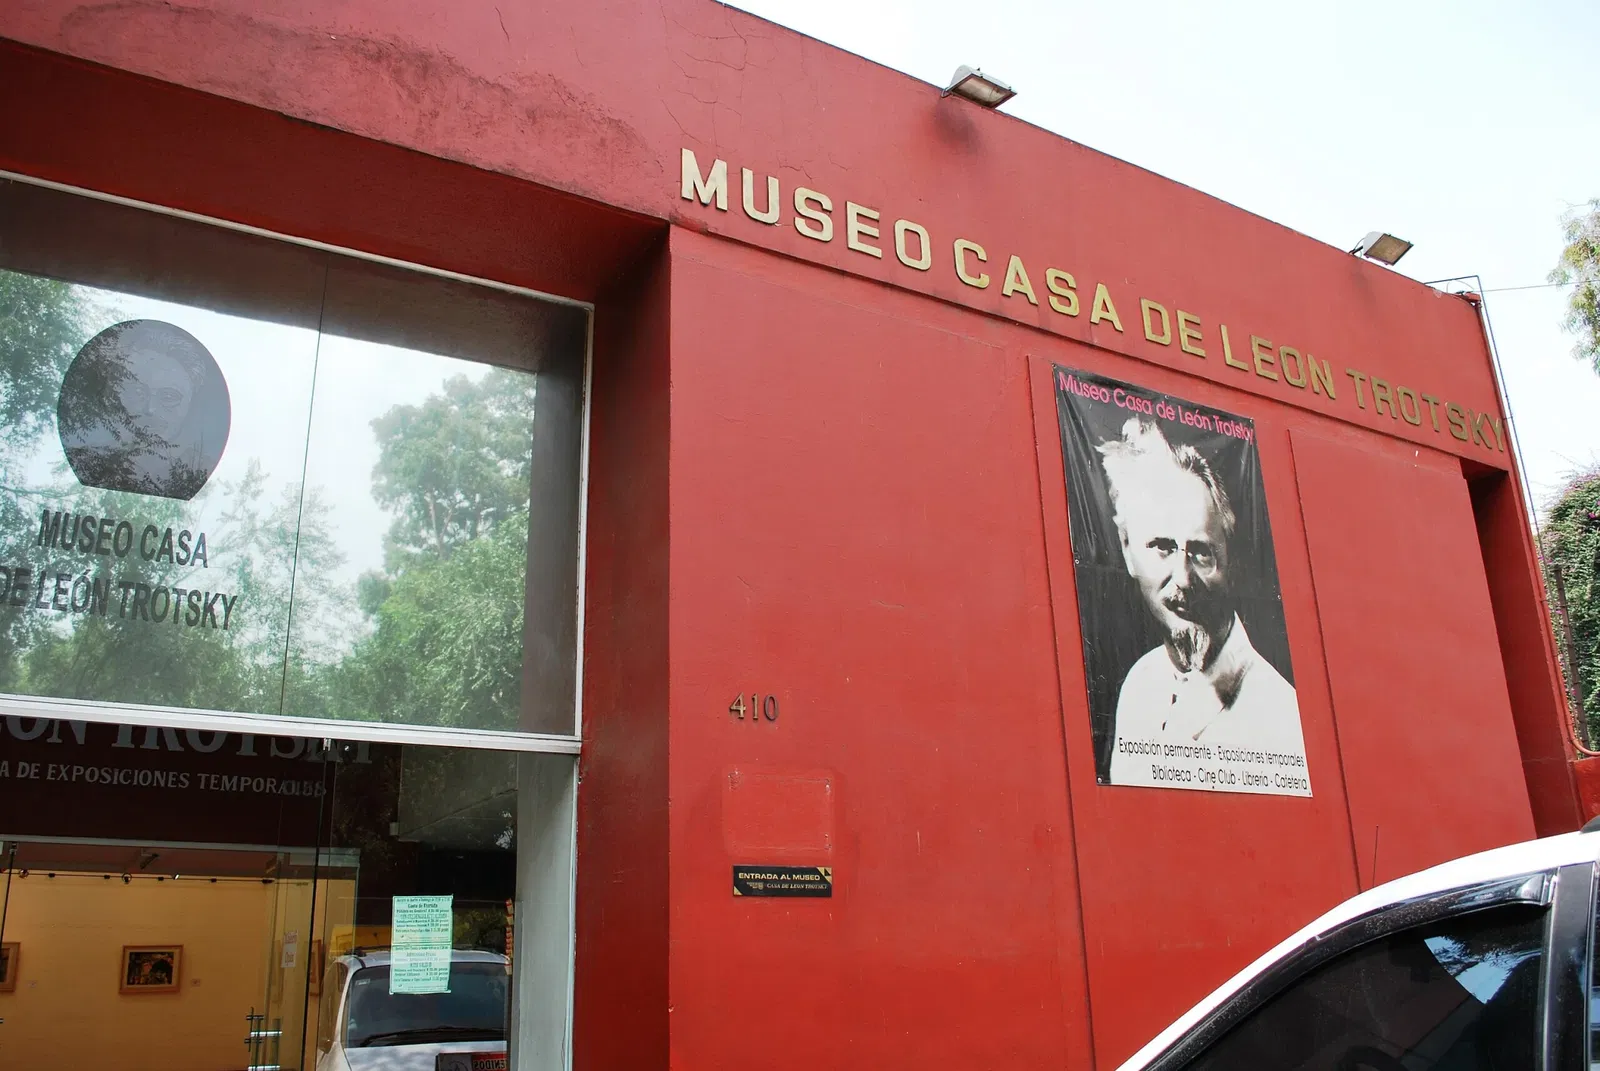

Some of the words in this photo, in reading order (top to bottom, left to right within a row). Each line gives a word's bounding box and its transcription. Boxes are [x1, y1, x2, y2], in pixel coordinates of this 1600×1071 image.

[681, 147, 932, 271] MUSEO
[953, 238, 1124, 332] CASA
[1140, 297, 1206, 358] DE
[1219, 324, 1336, 400] LEON
[1345, 367, 1504, 452] TROTSKY
[1058, 371, 1111, 404] Museo
[1113, 388, 1152, 415] Casa
[1156, 401, 1176, 421] de
[1178, 405, 1212, 431] León
[37, 509, 133, 559] MUSEO
[140, 524, 208, 568] CASA
[0, 566, 31, 608] DE
[35, 569, 111, 617] LEÓN
[118, 581, 238, 631] TROTSKY
[730, 691, 779, 721] 410
[17, 761, 41, 779] DE
[47, 763, 190, 789] EXPOSICIONES
[1118, 737, 1162, 760] Exposición
[1164, 743, 1211, 760] permanente
[1218, 745, 1265, 765] Exposiciones
[1265, 752, 1305, 768] temporales
[1151, 764, 1192, 782] Biblioteca
[1198, 767, 1216, 784] Cine
[1217, 769, 1236, 785] Club
